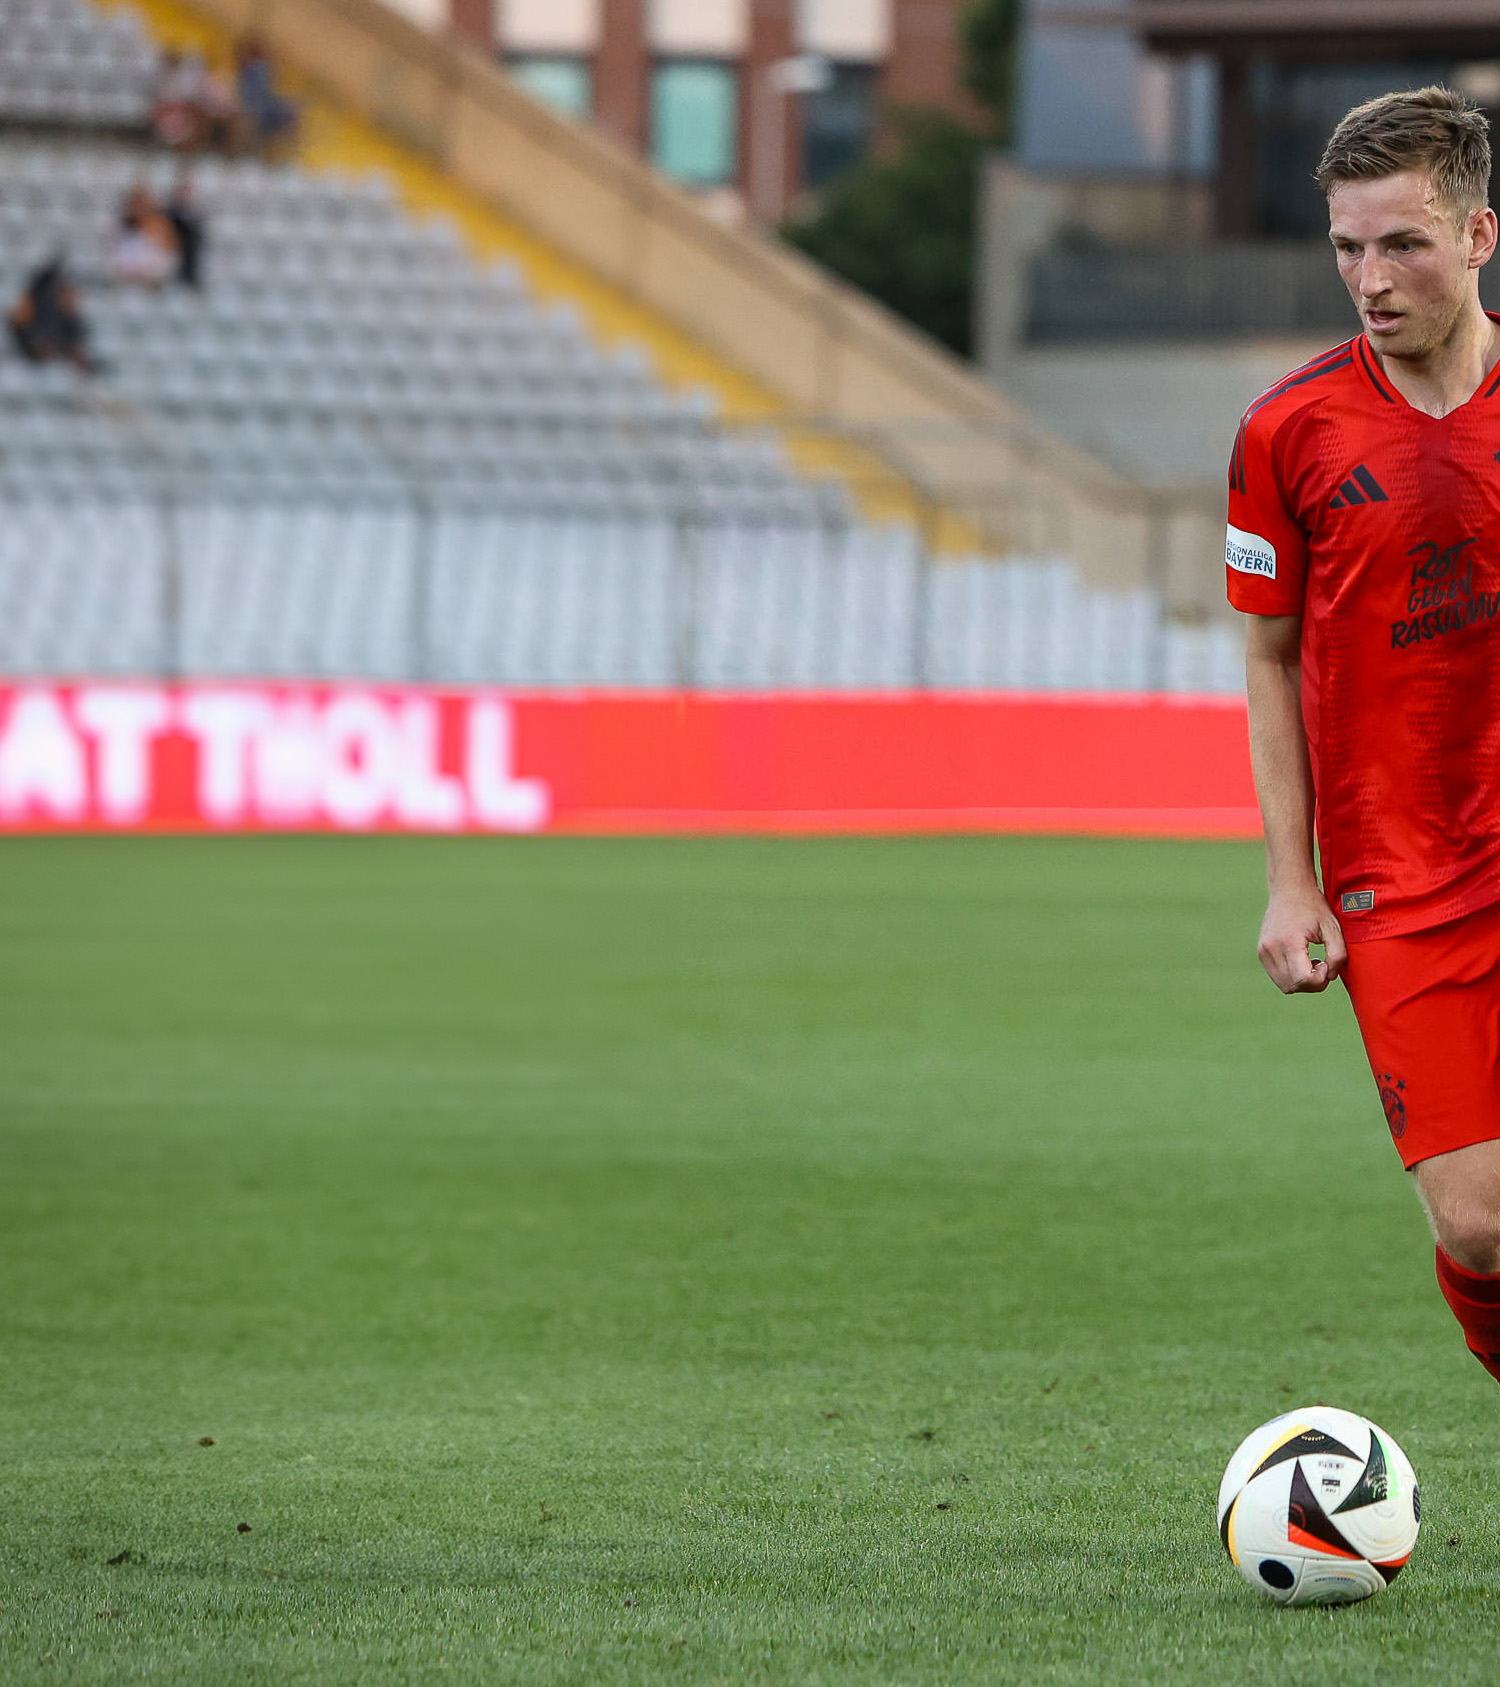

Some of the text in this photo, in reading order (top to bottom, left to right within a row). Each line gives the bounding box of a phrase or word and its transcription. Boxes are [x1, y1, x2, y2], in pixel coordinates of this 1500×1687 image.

[1227, 547, 1273, 574] BAYERN
[1406, 536, 1478, 586] ROT
[1408, 558, 1473, 614] GEGEN
